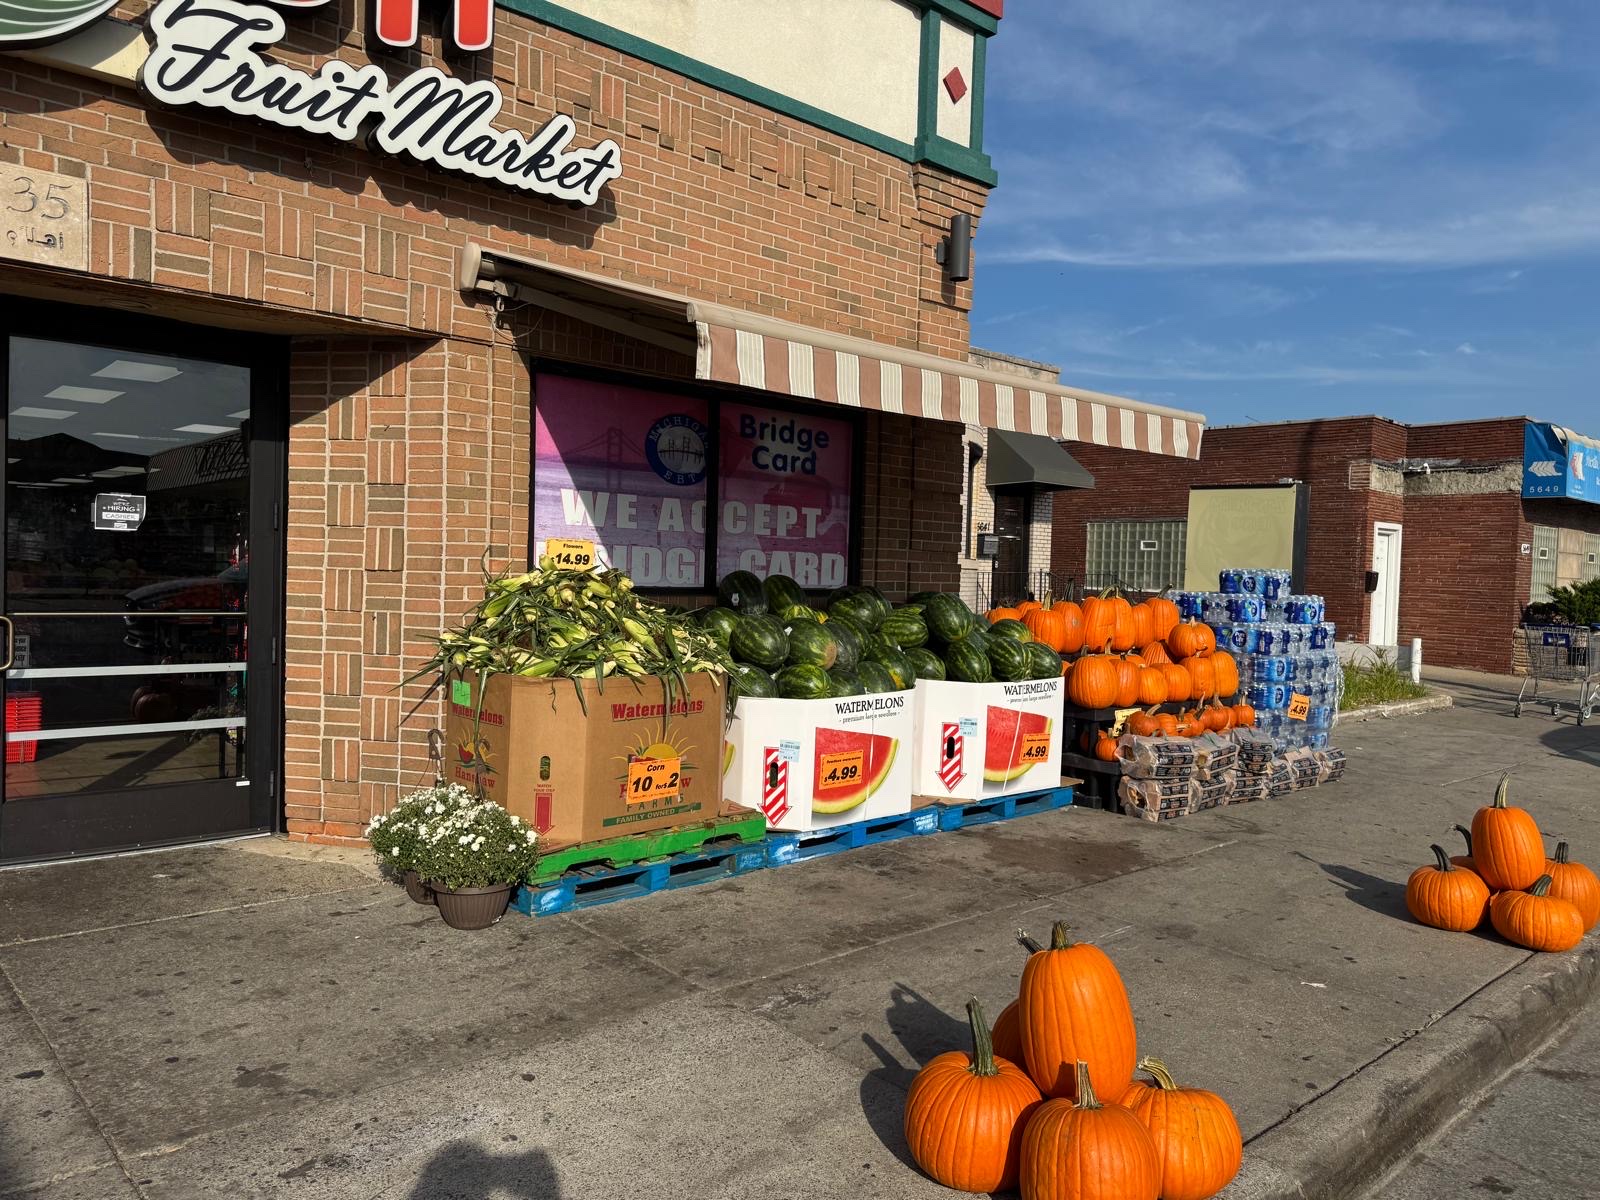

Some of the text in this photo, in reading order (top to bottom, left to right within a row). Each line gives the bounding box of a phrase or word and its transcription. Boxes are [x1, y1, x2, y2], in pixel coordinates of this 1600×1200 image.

[157, 0, 379, 129] Fruit
[387, 76, 615, 195] Market
[649, 416, 708, 449] MICHIGA
[740, 414, 830, 452] Bridge
[751, 446, 817, 475] Card
[664, 471, 696, 484] EBT
[560, 488, 822, 538] WE ACCEPT
[739, 549, 846, 587] CARD
[1004, 681, 1058, 696] WATERMELONS
[835, 696, 904, 714] WATERMELONS
[647, 764, 665, 772] Corn
[824, 765, 858, 783] $4.99
[632, 776, 653, 793] 10
[627, 794, 684, 812] FARMS
[616, 808, 675, 824] FAMILY OWNED
